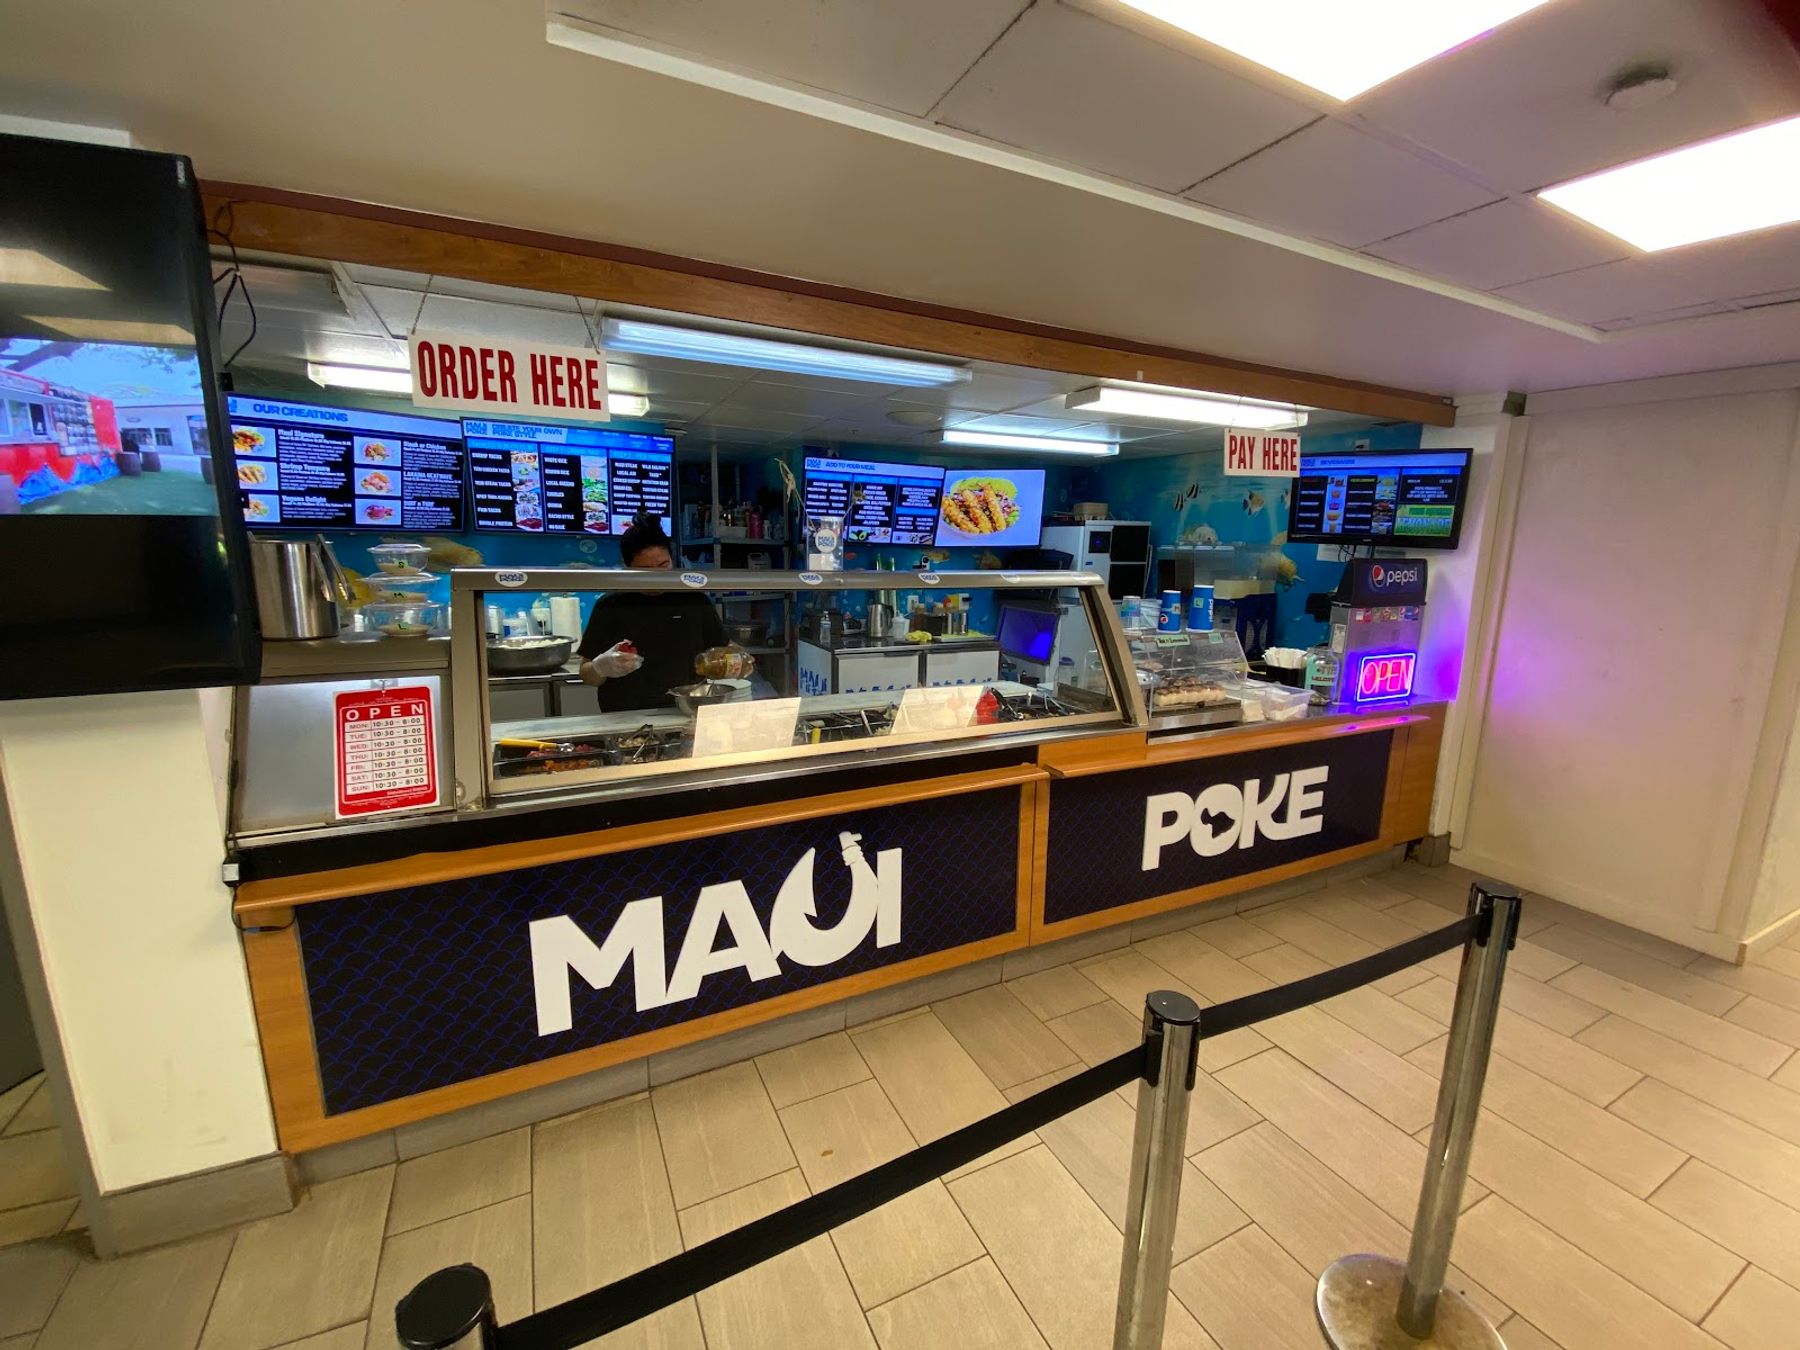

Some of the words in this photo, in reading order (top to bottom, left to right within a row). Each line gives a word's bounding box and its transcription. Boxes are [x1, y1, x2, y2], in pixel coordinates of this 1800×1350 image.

[417, 340, 518, 403] ORDER
[530, 353, 601, 410] HERE
[253, 404, 280, 415] OUR
[282, 407, 348, 422] CREATIONS
[543, 427, 563, 435] OWN
[1229, 435, 1256, 469] PAY
[1263, 437, 1297, 471] HERE
[1386, 567, 1418, 587] pepsi
[1362, 658, 1414, 695] OPEN
[346, 703, 424, 721] OPEN
[1142, 765, 1329, 872] POKE
[529, 831, 903, 1037] MAUI
